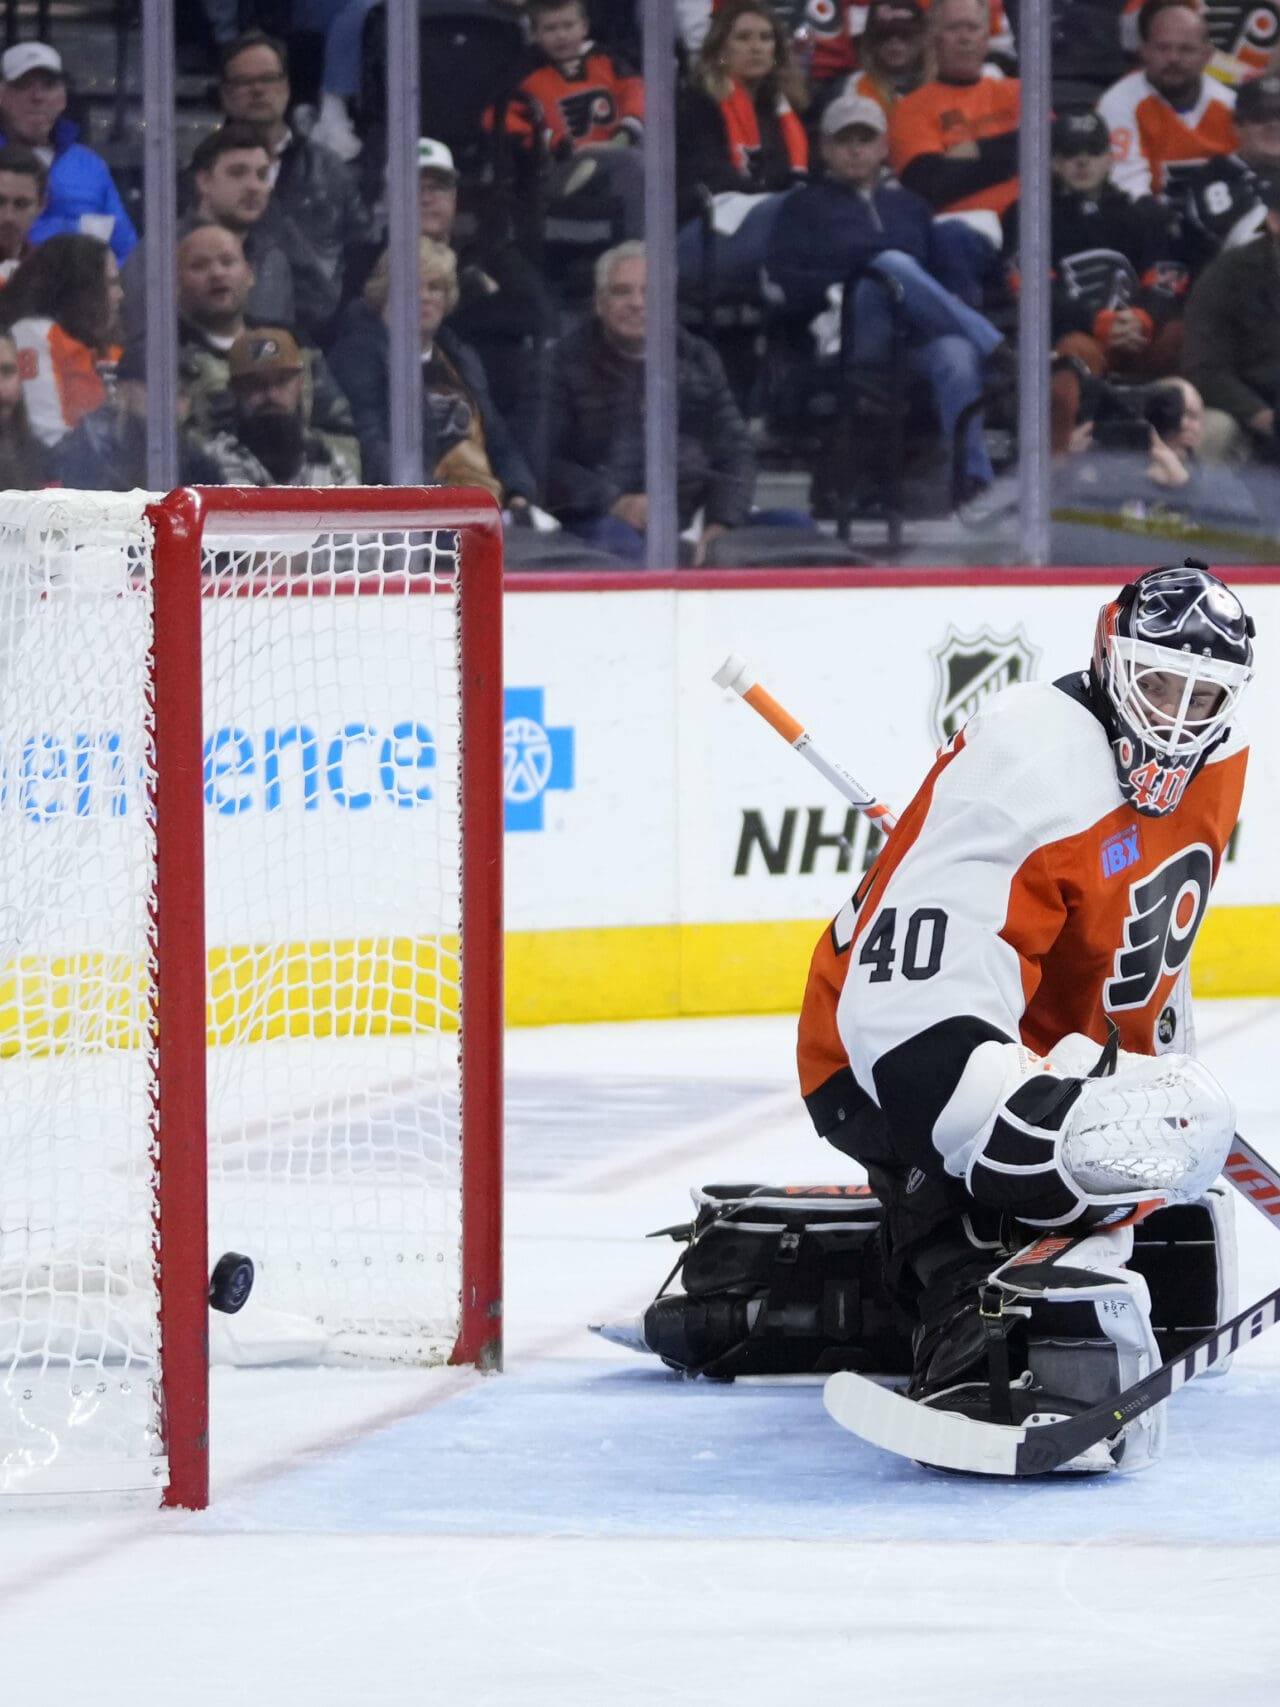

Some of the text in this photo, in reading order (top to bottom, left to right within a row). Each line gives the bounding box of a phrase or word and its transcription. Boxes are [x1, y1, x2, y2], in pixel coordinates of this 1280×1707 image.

[1129, 760, 1191, 812] 40
[1102, 832, 1141, 879] IBX
[859, 907, 948, 983] 40
